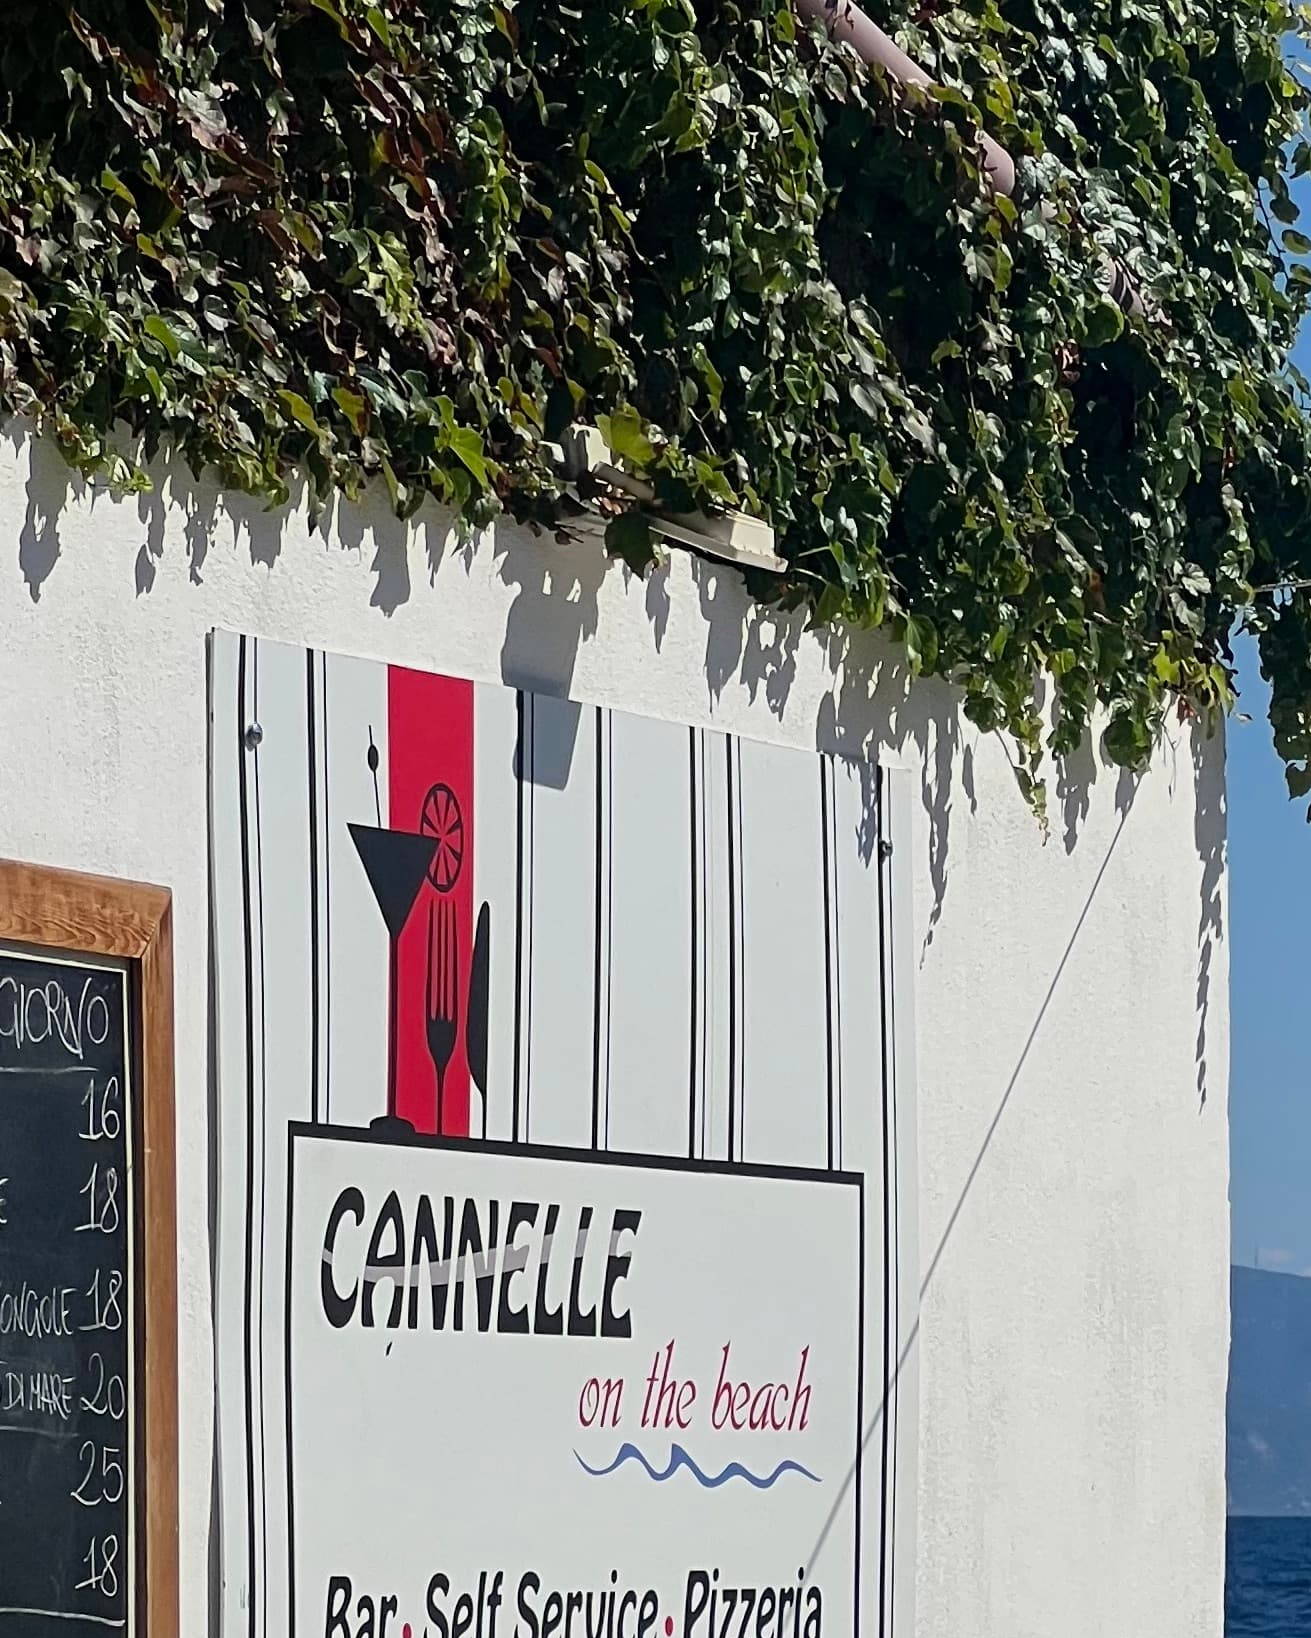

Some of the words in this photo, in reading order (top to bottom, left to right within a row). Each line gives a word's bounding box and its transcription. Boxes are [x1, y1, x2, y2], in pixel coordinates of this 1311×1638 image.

[78, 1076, 121, 1140] 16
[73, 1162, 120, 1233] 18
[320, 1186, 643, 1338] CANNELLE
[77, 1268, 123, 1331] 18
[29, 1372, 76, 1420] MARE
[79, 1352, 126, 1420] 20
[577, 1377, 624, 1428] on
[640, 1339, 696, 1429] the
[710, 1341, 813, 1431] beach
[70, 1440, 124, 1506] 25
[74, 1534, 118, 1597] 18
